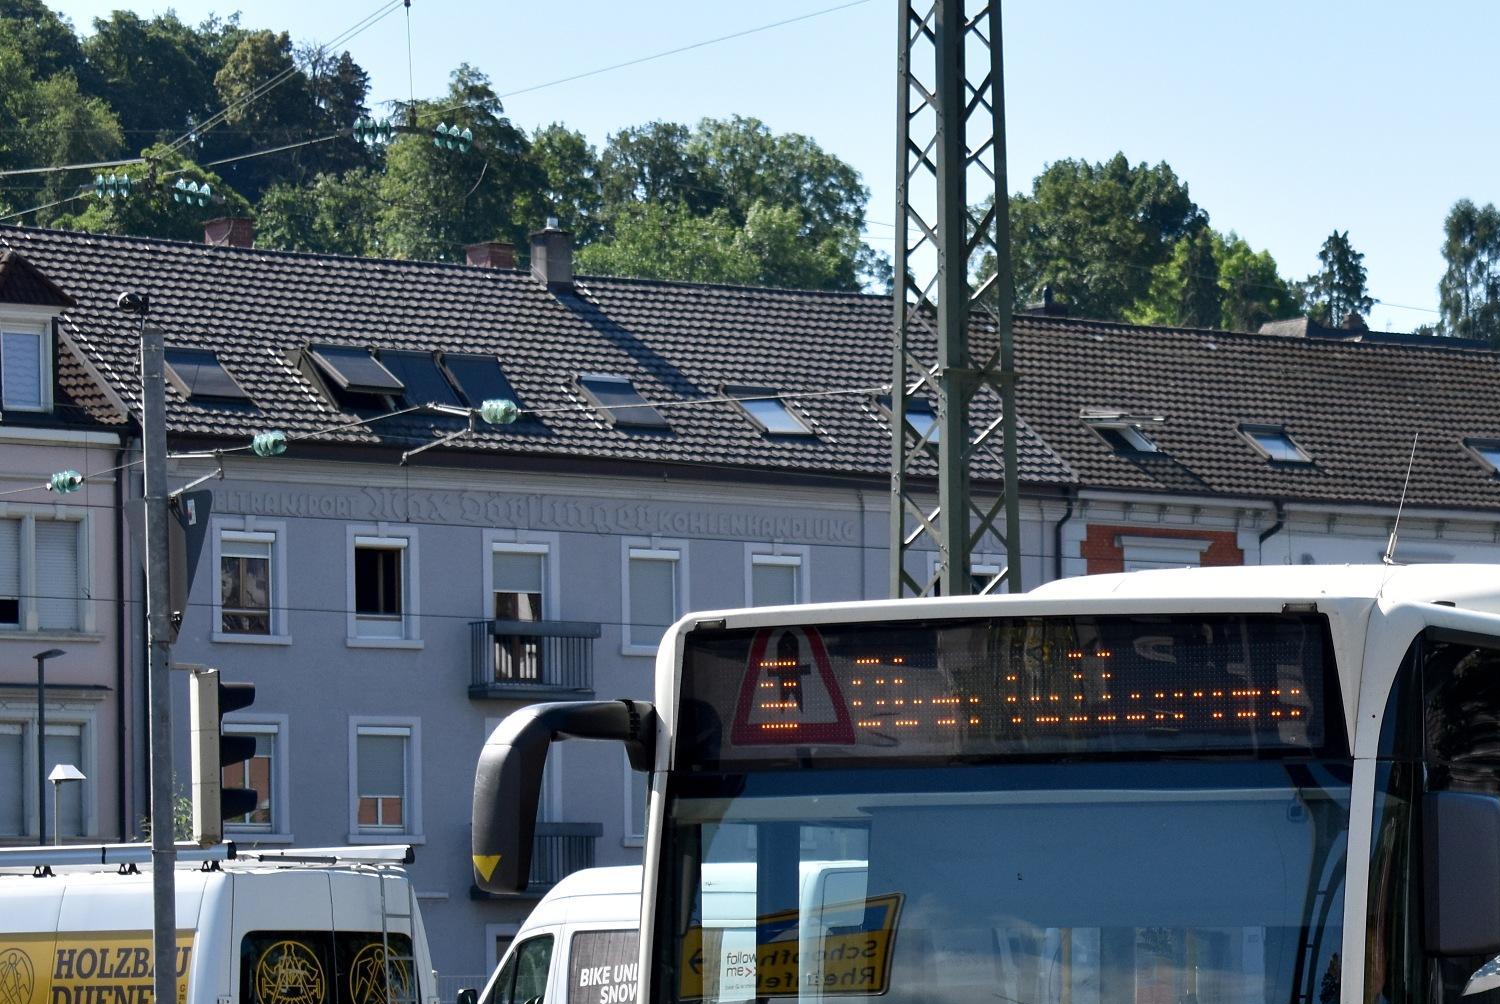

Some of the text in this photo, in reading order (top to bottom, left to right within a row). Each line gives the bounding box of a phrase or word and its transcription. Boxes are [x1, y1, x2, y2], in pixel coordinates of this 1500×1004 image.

[213, 490, 361, 516] ELTRANSPORT
[657, 510, 856, 542] KOHLENHANDLUNG
[53, 946, 193, 980] HOLZBU
[580, 965, 611, 987] BIKE
